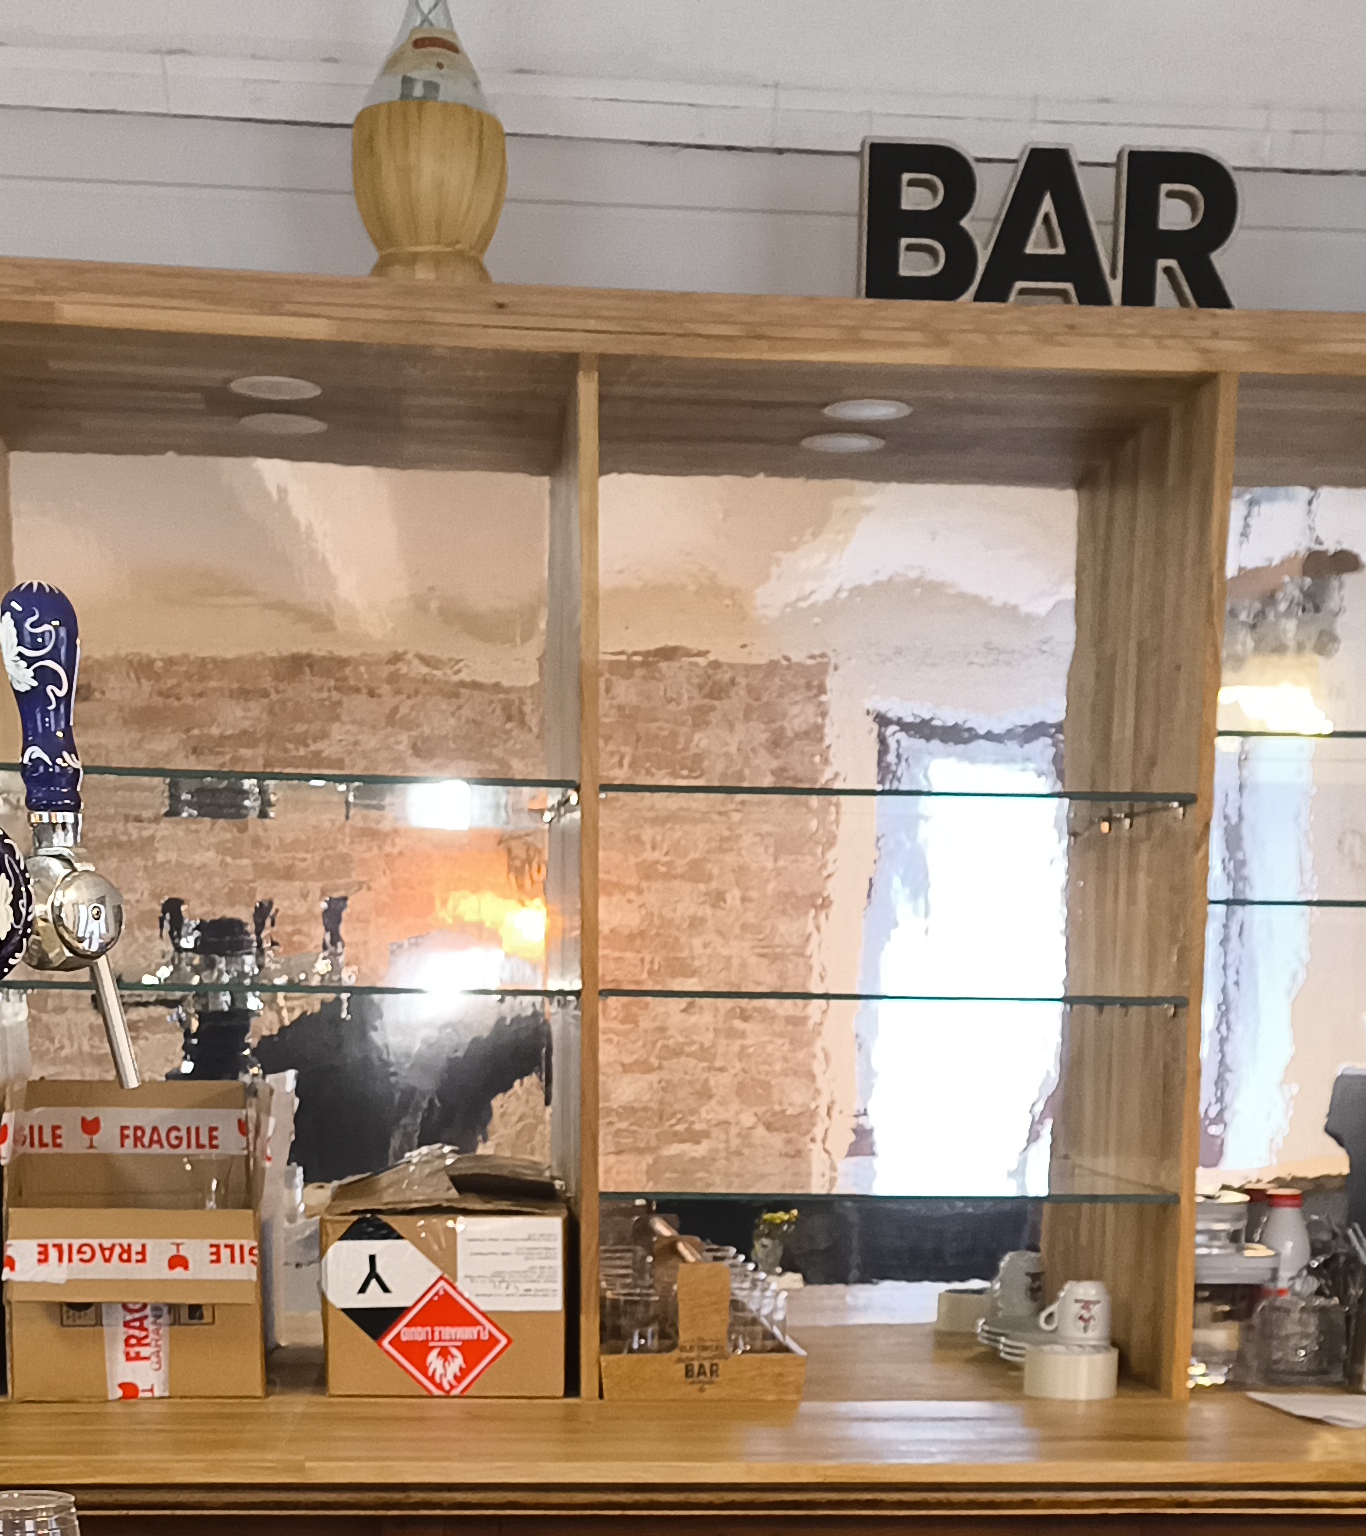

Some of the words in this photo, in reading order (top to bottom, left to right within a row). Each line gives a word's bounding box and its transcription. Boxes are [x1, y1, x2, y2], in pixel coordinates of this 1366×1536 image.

[862, 139, 1240, 310] BAR
[119, 1124, 220, 1150] FRAGILE
[36, 1242, 148, 1265] FRAGILE
[356, 1253, 393, 1295] Y
[684, 1362, 720, 1380] BAR
